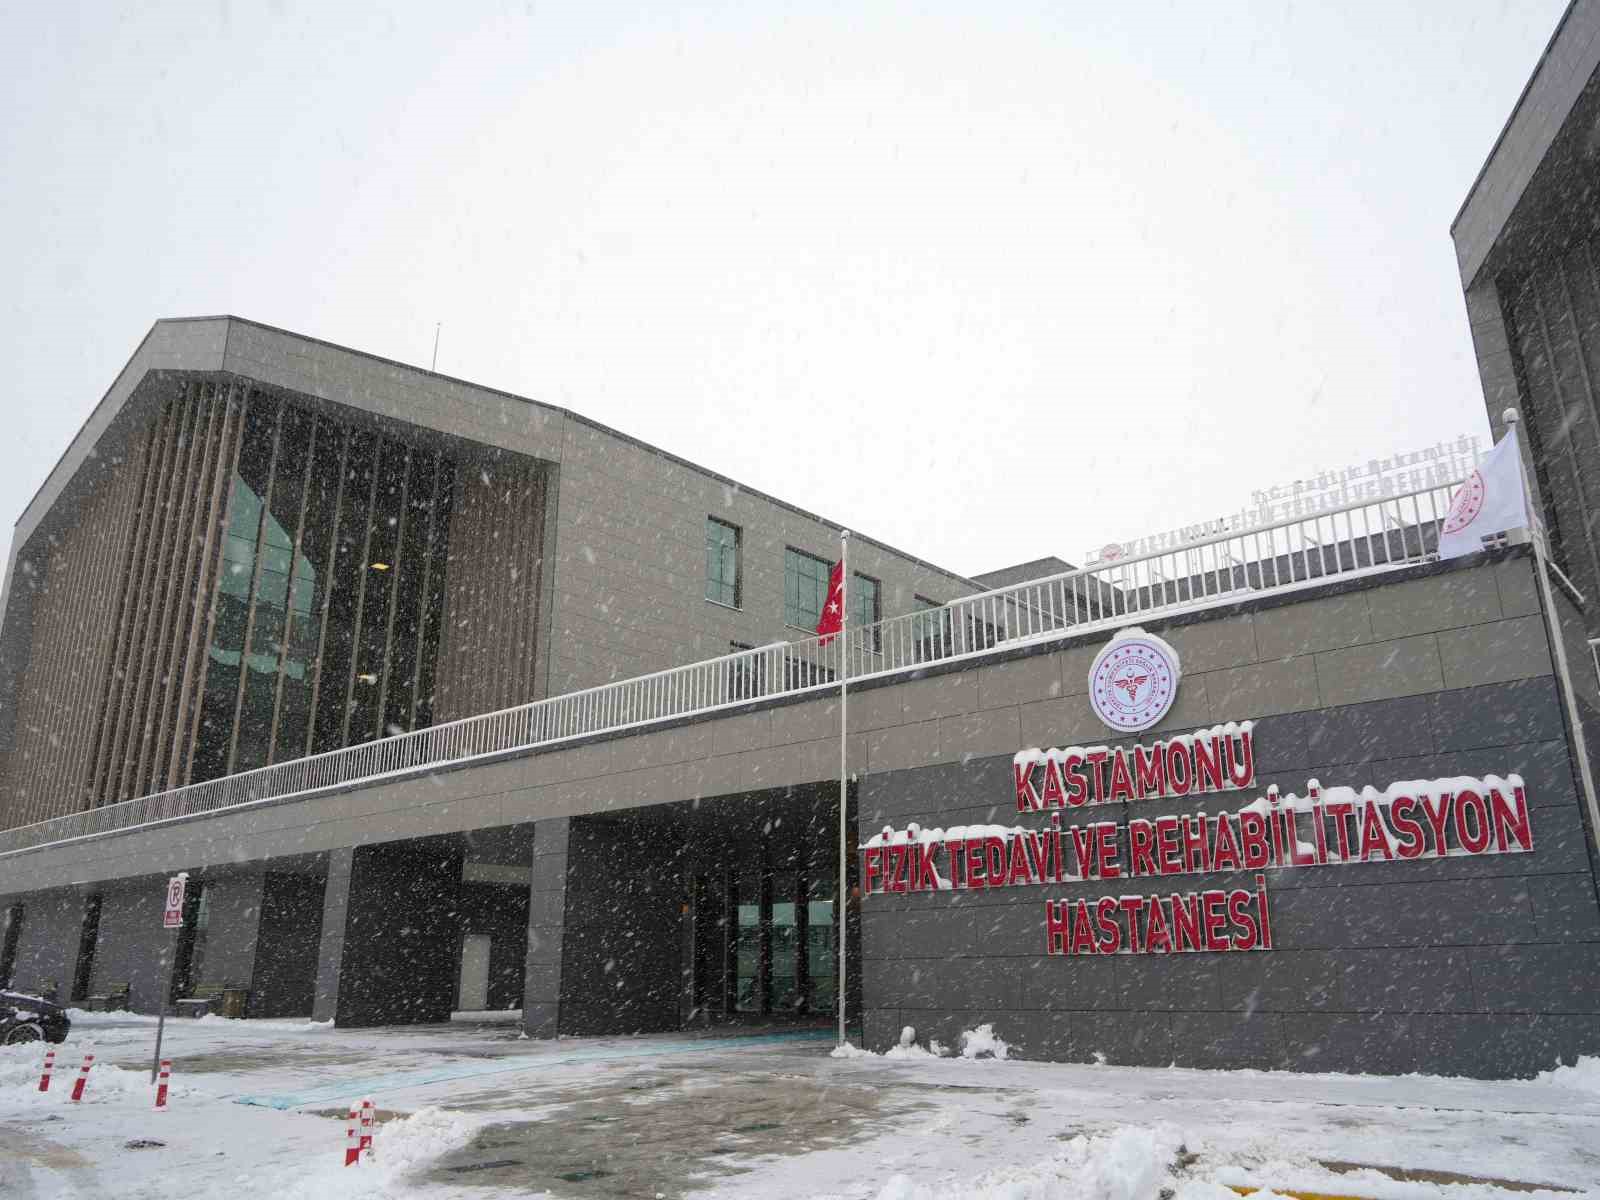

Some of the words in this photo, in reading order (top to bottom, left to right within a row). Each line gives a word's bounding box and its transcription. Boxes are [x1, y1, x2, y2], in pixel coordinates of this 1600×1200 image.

[1013, 731, 1254, 812] KASTAMONU
[864, 830, 940, 895] FİZİK
[944, 813, 1062, 889] TEDAVİ
[1070, 822, 1121, 880] VE
[1129, 786, 1533, 875] REHABİLİTASYON
[1046, 874, 1272, 954] HASTANESİ
